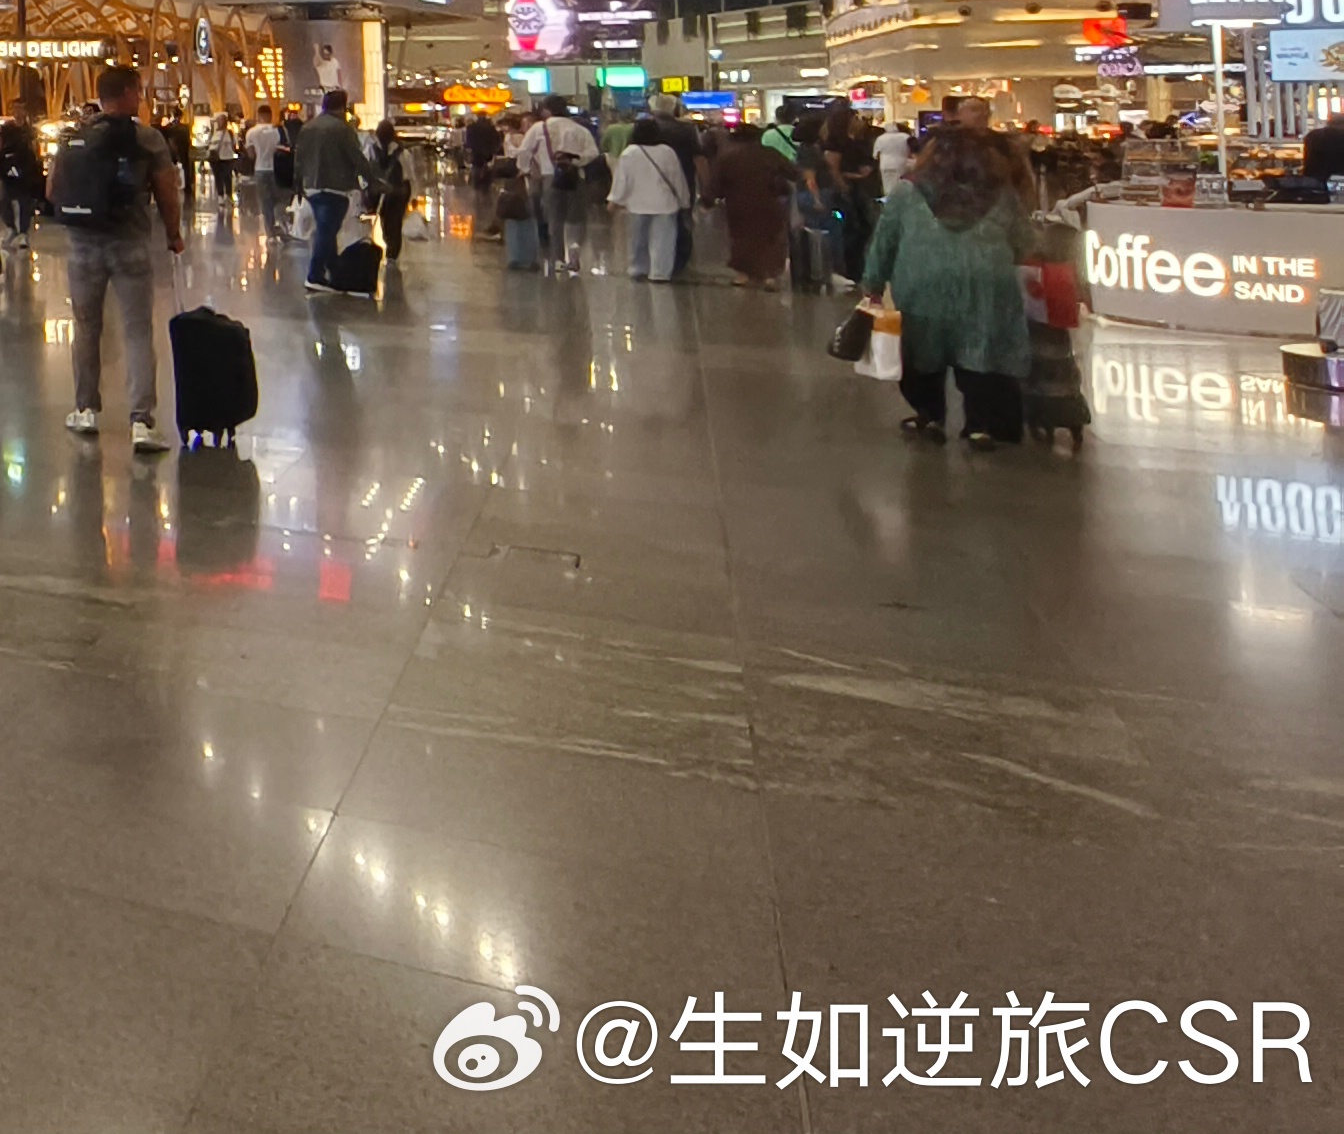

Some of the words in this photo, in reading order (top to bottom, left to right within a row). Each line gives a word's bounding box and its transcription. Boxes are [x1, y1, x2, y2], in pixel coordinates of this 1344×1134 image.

[26, 40, 102, 58] DELIGHT
[1085, 229, 1227, 297] Coffee
[1232, 254, 1257, 274] IN
[1261, 256, 1317, 278] THE
[1234, 280, 1306, 303] SAND
